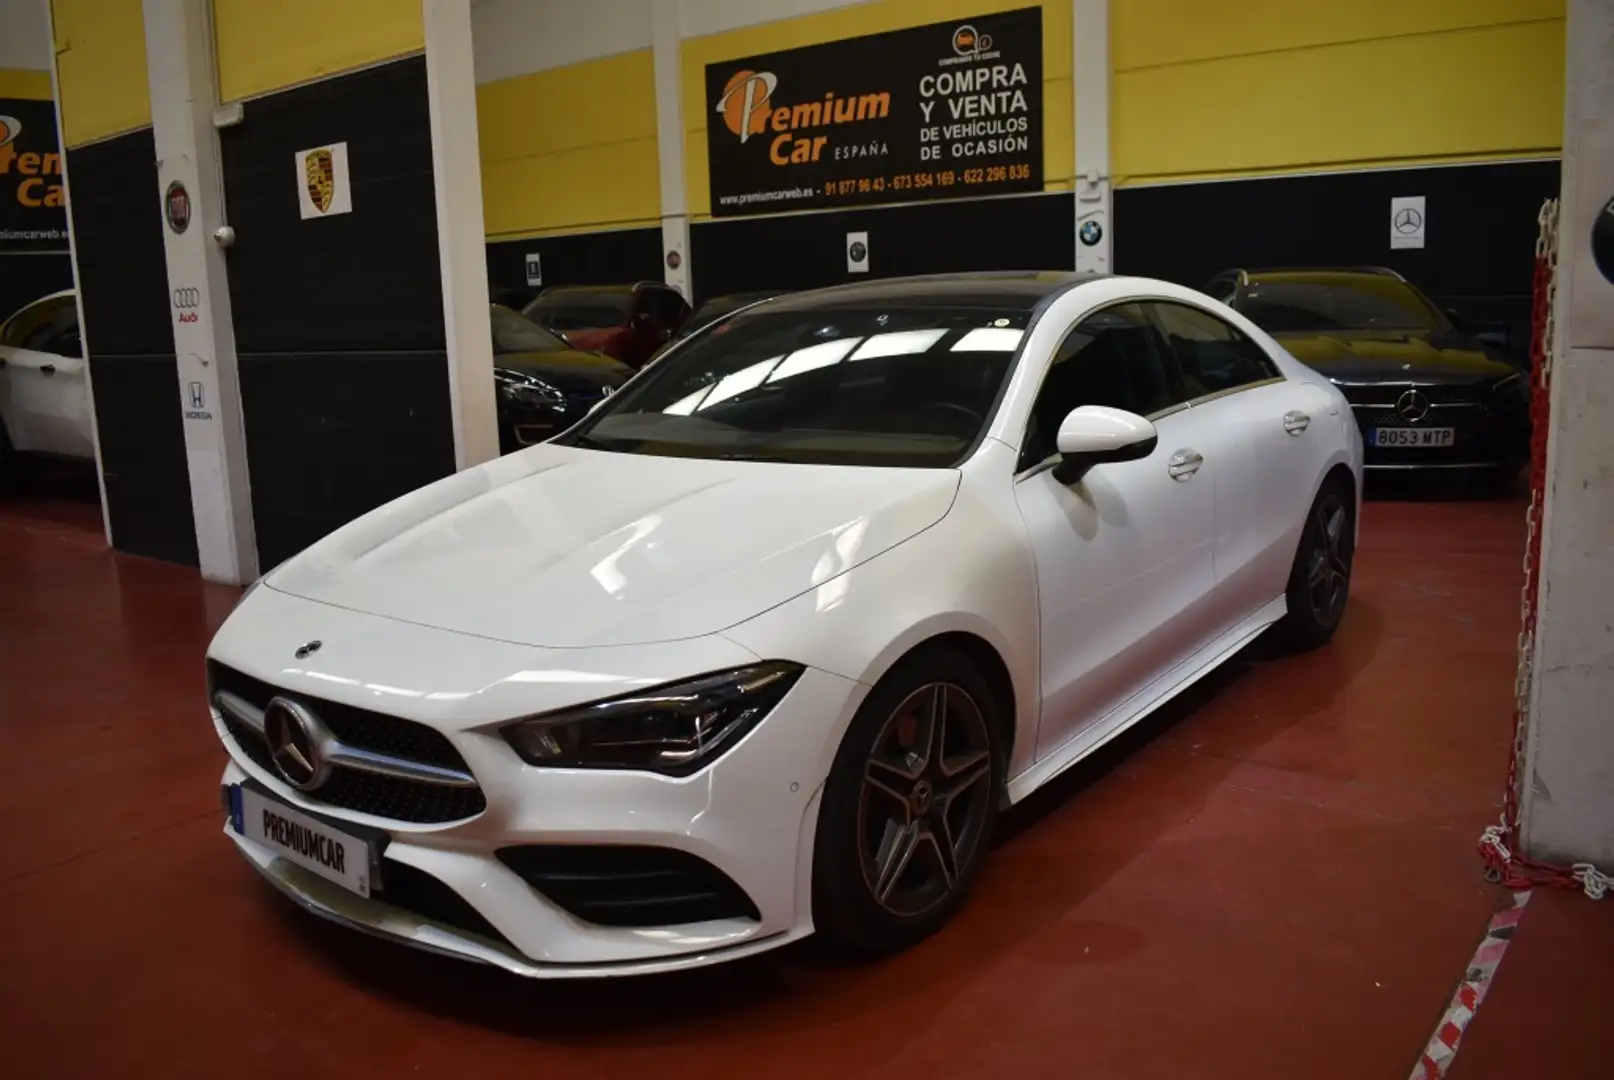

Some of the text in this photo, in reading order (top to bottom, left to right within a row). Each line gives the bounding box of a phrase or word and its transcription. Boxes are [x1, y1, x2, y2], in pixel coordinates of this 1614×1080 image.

[919, 63, 1028, 97] COMPRA
[715, 71, 891, 144] Premium
[919, 89, 1028, 123] Y VENTA
[920, 117, 1028, 142] DE VEHÍCULOS
[769, 132, 828, 166] Car
[833, 141, 889, 161] ESPAÑA
[920, 134, 1028, 161] DE OCASIÓN
[17, 178, 66, 207] Ca
[718, 186, 814, 206] www.premiumcarweb.es
[963, 168, 984, 184] 622
[178, 311, 198, 323] Audi
[185, 411, 212, 421] HONDA
[262, 808, 346, 874] PREMIUMCAR
